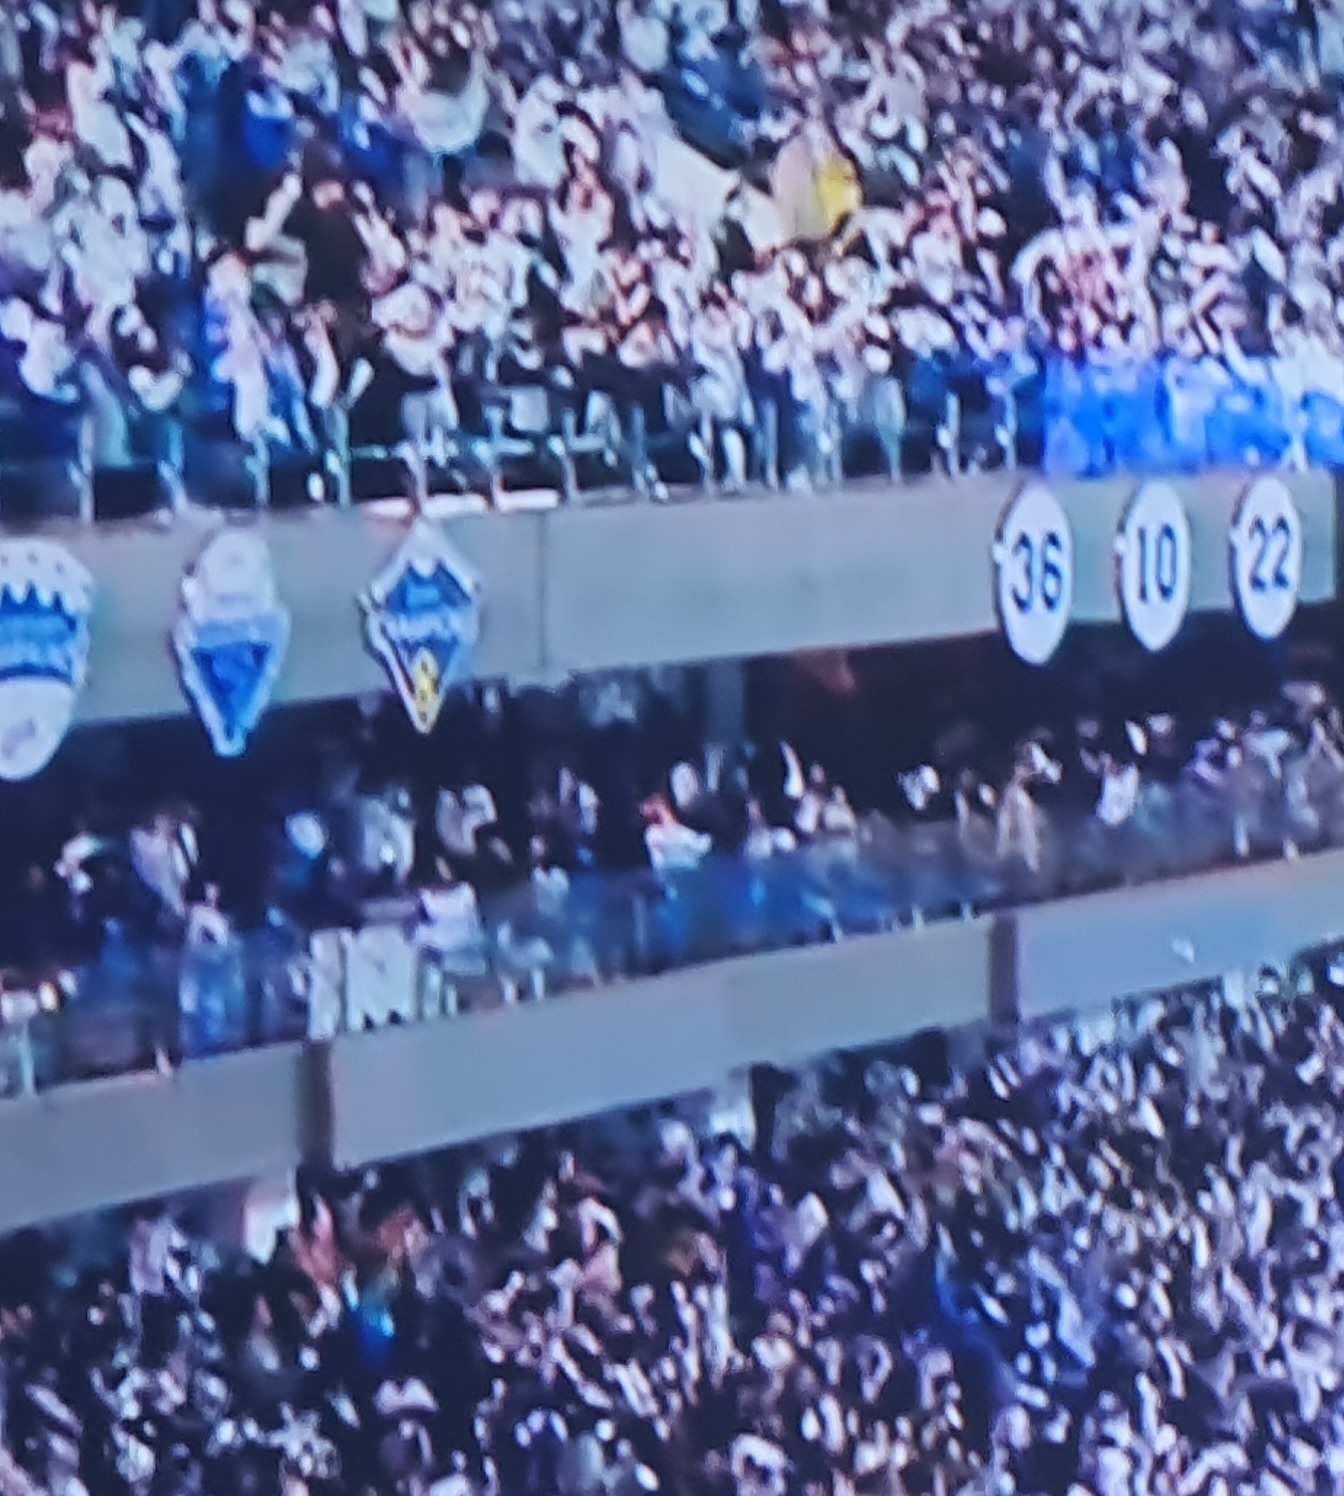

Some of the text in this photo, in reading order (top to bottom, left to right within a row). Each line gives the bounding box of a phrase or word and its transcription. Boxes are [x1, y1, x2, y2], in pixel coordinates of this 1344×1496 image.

[1011, 531, 1063, 614] 36
[1138, 523, 1176, 604] 10
[1250, 516, 1291, 591] 22
